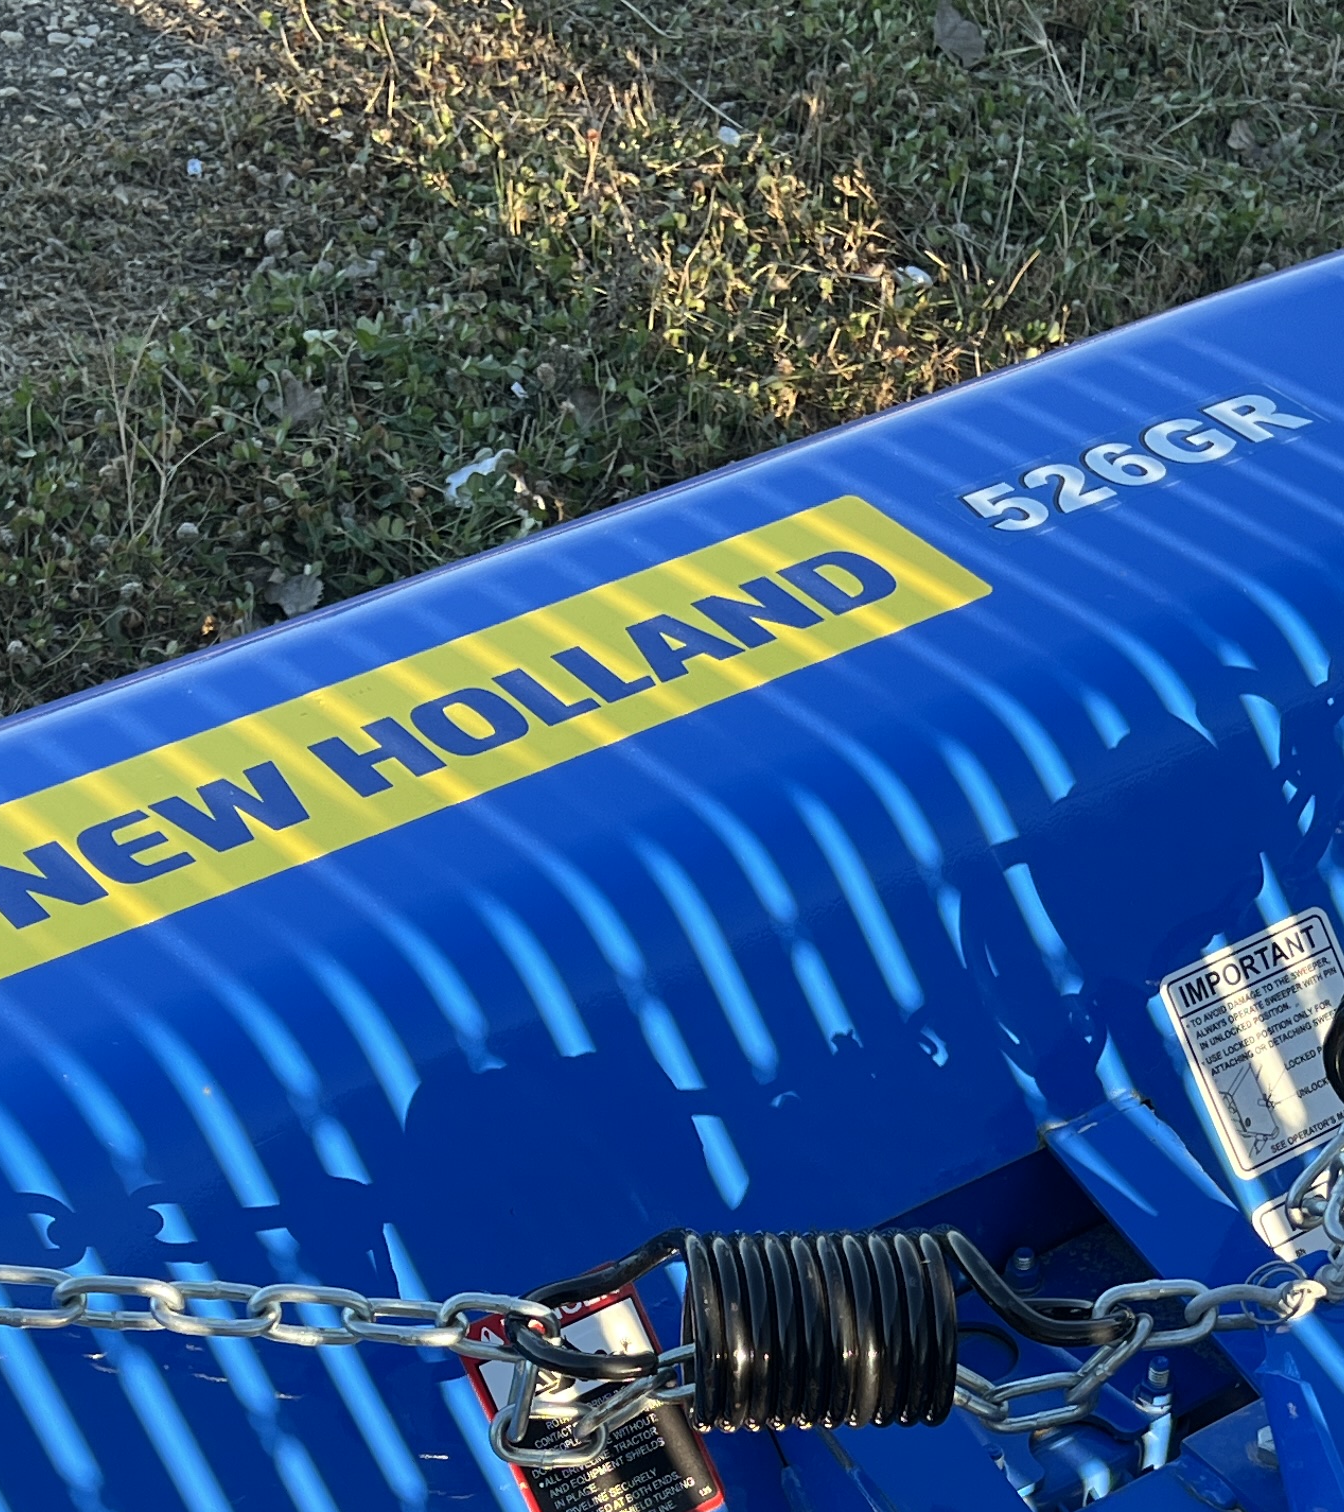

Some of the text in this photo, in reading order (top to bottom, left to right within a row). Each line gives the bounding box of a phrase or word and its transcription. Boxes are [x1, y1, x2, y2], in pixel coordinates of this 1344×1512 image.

[959, 394, 1313, 531] 526GR
[307, 550, 898, 798] HOLLAND
[1177, 923, 1320, 1008] IMPORTANT
[1190, 1016, 1203, 1028] TO
[1201, 1004, 1227, 1022] AVOID
[1226, 987, 1261, 1010] DAMAGE
[1261, 981, 1274, 993] TO
[1273, 974, 1290, 988] THE
[1194, 1018, 1227, 1040] ALWAYS
[1226, 1000, 1264, 1024] OPERATE
[1263, 982, 1302, 1006] SWEEPER
[1302, 972, 1323, 987] WITH
[1199, 1040, 1209, 1051] IN
[1208, 1019, 1252, 1046] UNLOCKED
[1205, 998, 1331, 1065] USE LOCKED POSITION ONLY FOR
[1209, 1049, 1254, 1077] ATTACHING
[1254, 1042, 1267, 1055] OR
[1267, 1020, 1312, 1049] DETACHING
[1283, 1048, 1317, 1070] LOCKED
[1296, 1076, 1330, 1098] UNLOCK
[1270, 1140, 1287, 1154] SEE
[543, 1474, 561, 1487] ALL
[612, 1425, 659, 1453] TRACTOR
[548, 1436, 665, 1498] AND EQUIPMENT SHIELDS
[607, 1466, 658, 1498] SECURELY
[553, 1499, 565, 1510] IN
[611, 1497, 626, 1510] AT
[624, 1483, 652, 1504] BOTH
[652, 1474, 695, 1505] TURNING
